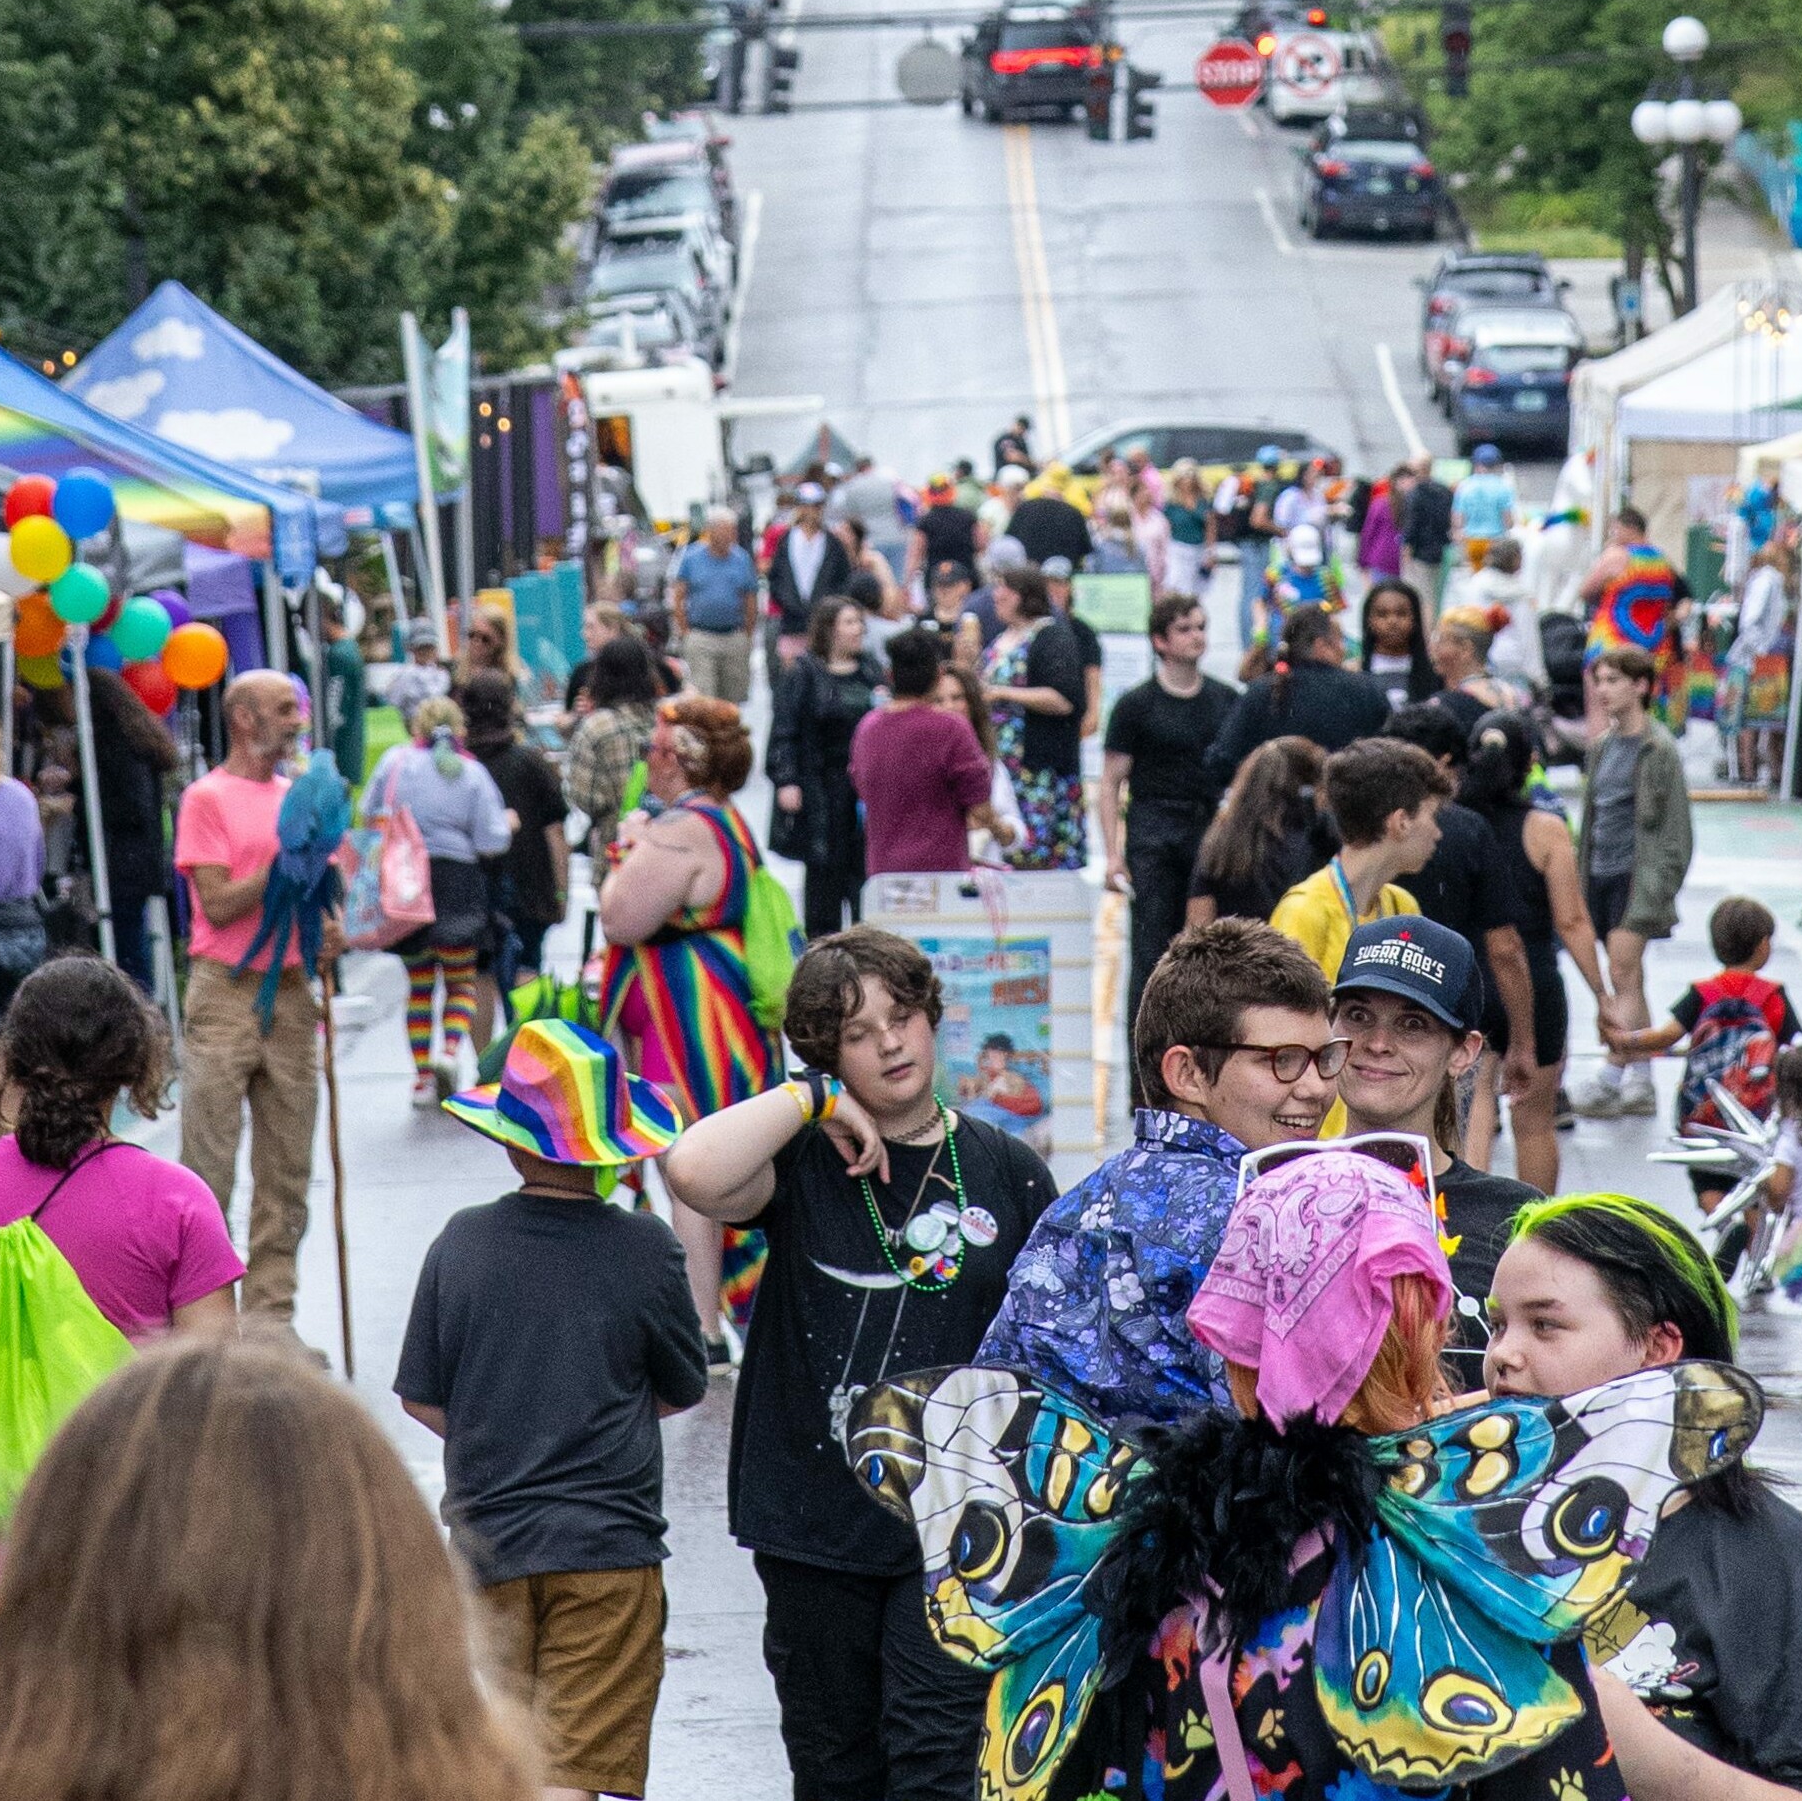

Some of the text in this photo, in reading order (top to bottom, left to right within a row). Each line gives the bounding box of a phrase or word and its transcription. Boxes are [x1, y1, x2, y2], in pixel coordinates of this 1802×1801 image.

[1200, 60, 1259, 83] STOP
[1354, 944, 1446, 979] SUGAR BOB'S
